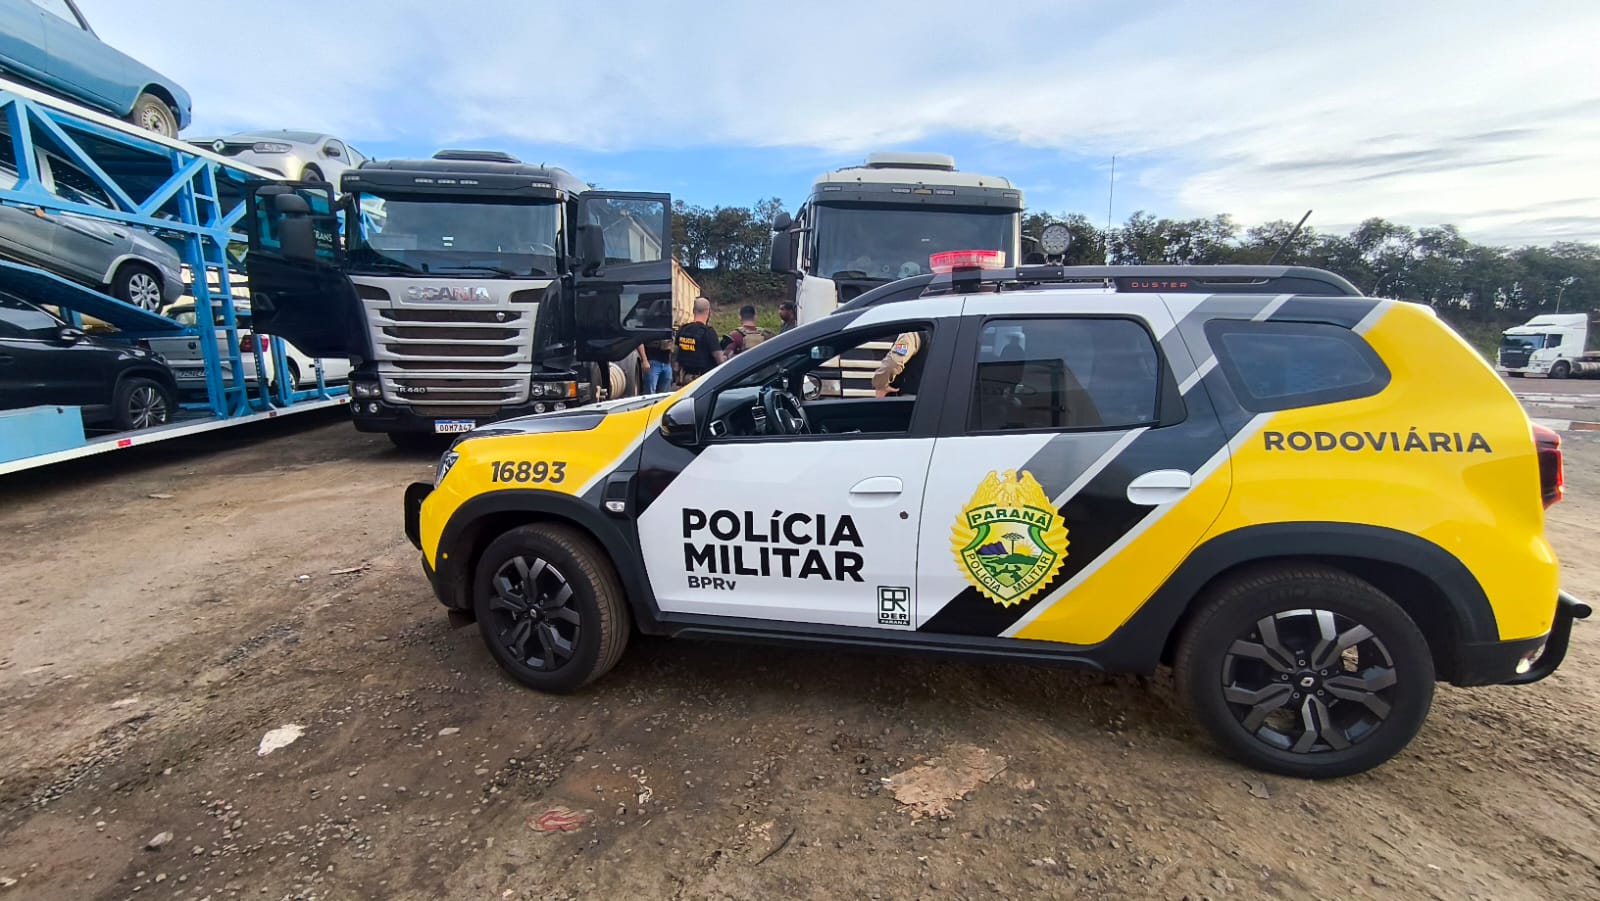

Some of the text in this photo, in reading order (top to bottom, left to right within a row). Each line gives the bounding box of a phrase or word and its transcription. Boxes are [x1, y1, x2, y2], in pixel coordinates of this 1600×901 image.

[407, 286, 490, 301] SCANIA
[1131, 281, 1188, 289] DUSTER
[1263, 426, 1493, 453] RODOVIÁRIA
[491, 461, 568, 484] 16893
[971, 508, 1048, 526] PARANÁ
[683, 542, 865, 582] MILITAR
[1012, 556, 1050, 593] MILITAR
